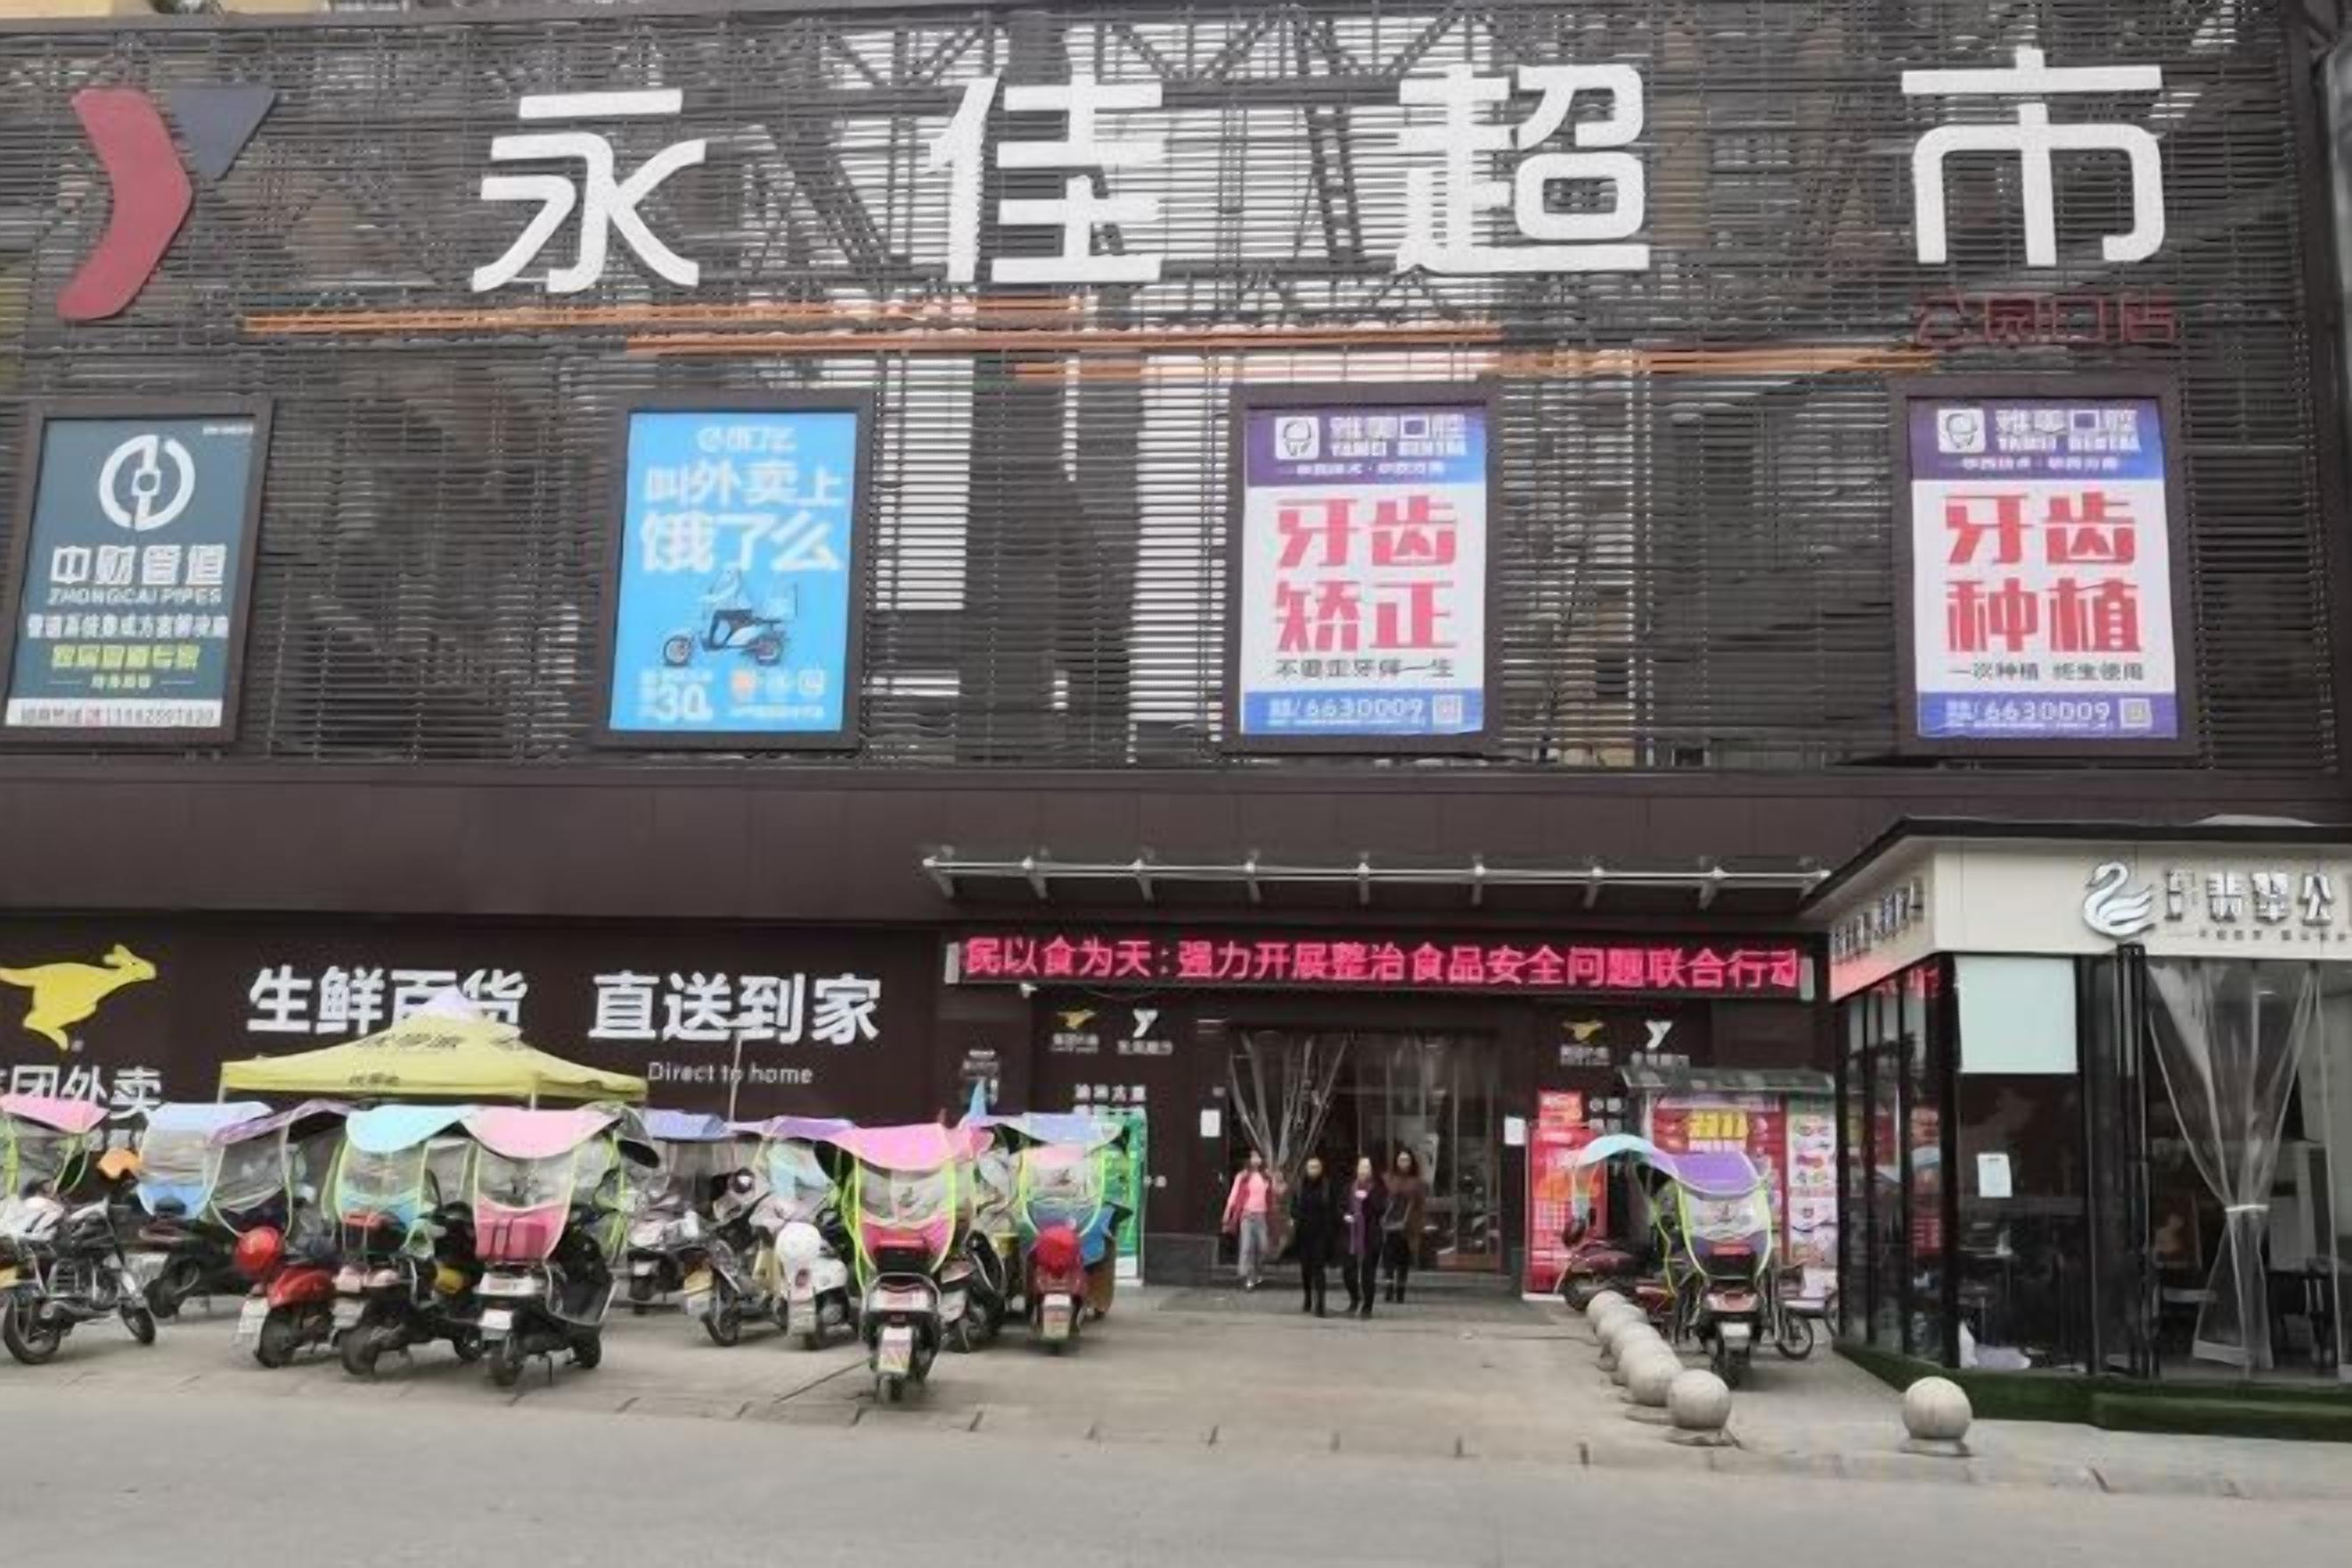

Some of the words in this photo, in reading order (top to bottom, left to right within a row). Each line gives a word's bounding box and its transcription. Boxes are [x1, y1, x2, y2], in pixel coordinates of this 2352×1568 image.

[471, 45, 2165, 292] 永佳超市
[645, 459, 845, 507] 叫外卖上
[641, 509, 842, 574] 饿了么
[1276, 494, 1458, 569] 牙齿
[1945, 491, 2136, 566] 牙齿
[1276, 580, 1458, 652] 矫正
[1946, 577, 2141, 652] 种植
[247, 965, 528, 1035] 生鲜百货
[588, 970, 881, 1045] 直送到家
[0, 1065, 162, 1121] 团外卖
[648, 1061, 713, 1083] Direct
[749, 1063, 813, 1084] home
